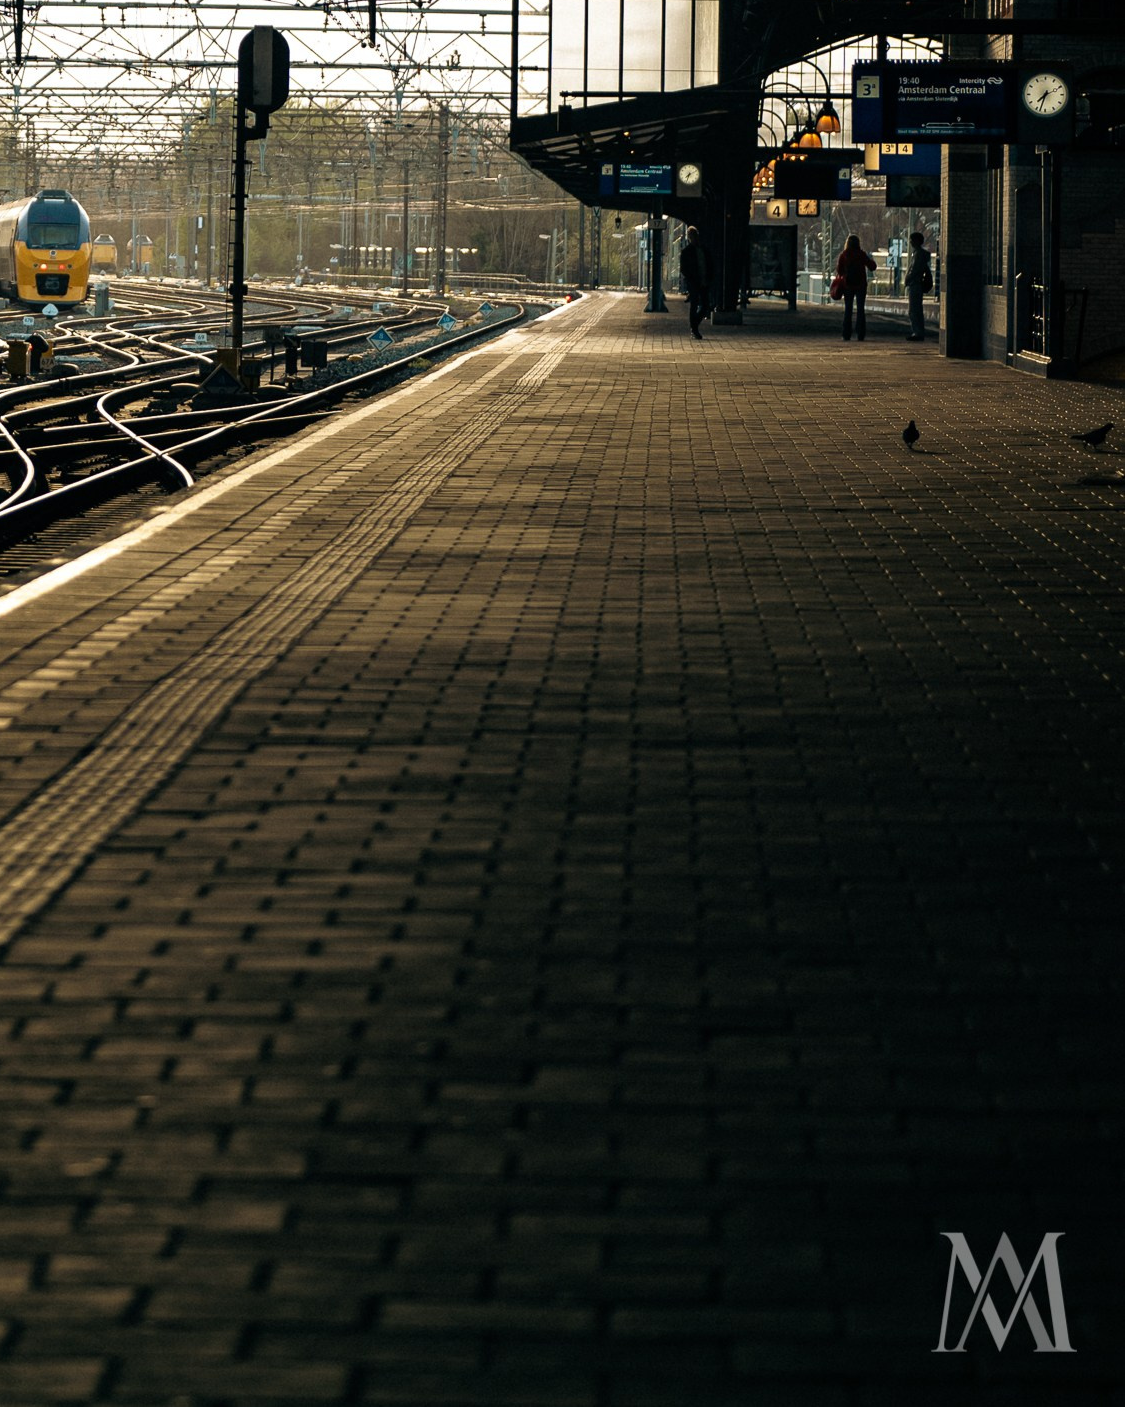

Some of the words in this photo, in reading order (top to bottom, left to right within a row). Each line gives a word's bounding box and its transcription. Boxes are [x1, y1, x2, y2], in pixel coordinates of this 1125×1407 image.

[898, 76, 920, 84] 19:40
[959, 77, 986, 85] Intercity
[898, 85, 947, 94] Amsterdam
[949, 85, 986, 94] Centraal
[902, 145, 908, 153] 4
[772, 205, 781, 217] 4
